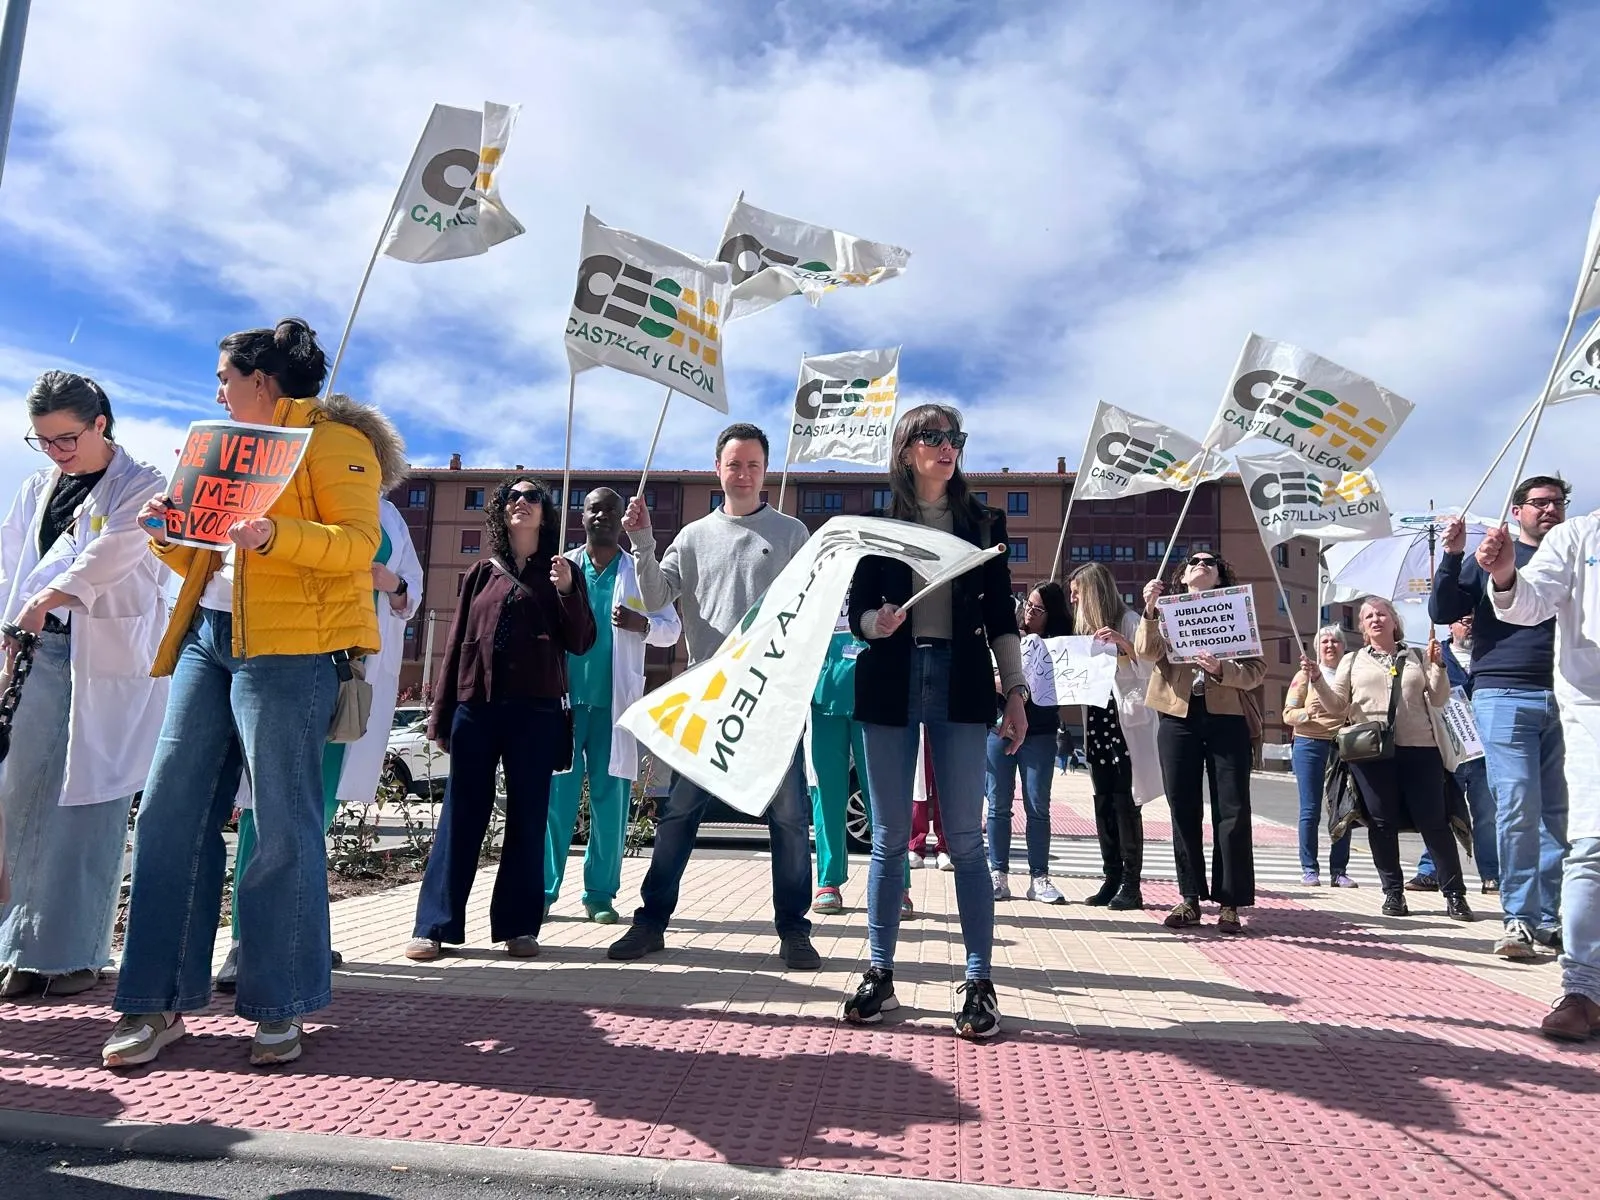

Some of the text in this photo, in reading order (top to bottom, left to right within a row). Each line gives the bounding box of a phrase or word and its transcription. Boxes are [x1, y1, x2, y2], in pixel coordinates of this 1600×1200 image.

[574, 254, 719, 367] CESM
[565, 317, 714, 393] CASTILLA y LEÓN
[1233, 369, 1388, 463] CESM
[849, 427, 857, 438] y
[860, 422, 887, 437] LEÓN
[1223, 408, 1353, 472] CASTILLA y LEÓN
[181, 431, 302, 477] SE VENDE
[1091, 467, 1129, 487] CASTI
[1260, 500, 1380, 527] CASTILLA y LEÓN
[1174, 602, 1232, 617] JUBILACIÓN
[1178, 613, 1234, 627] BASADA EN
[1175, 634, 1246, 649] LA PENOSIDAD
[1179, 624, 1236, 638] EL RIESGO Y
